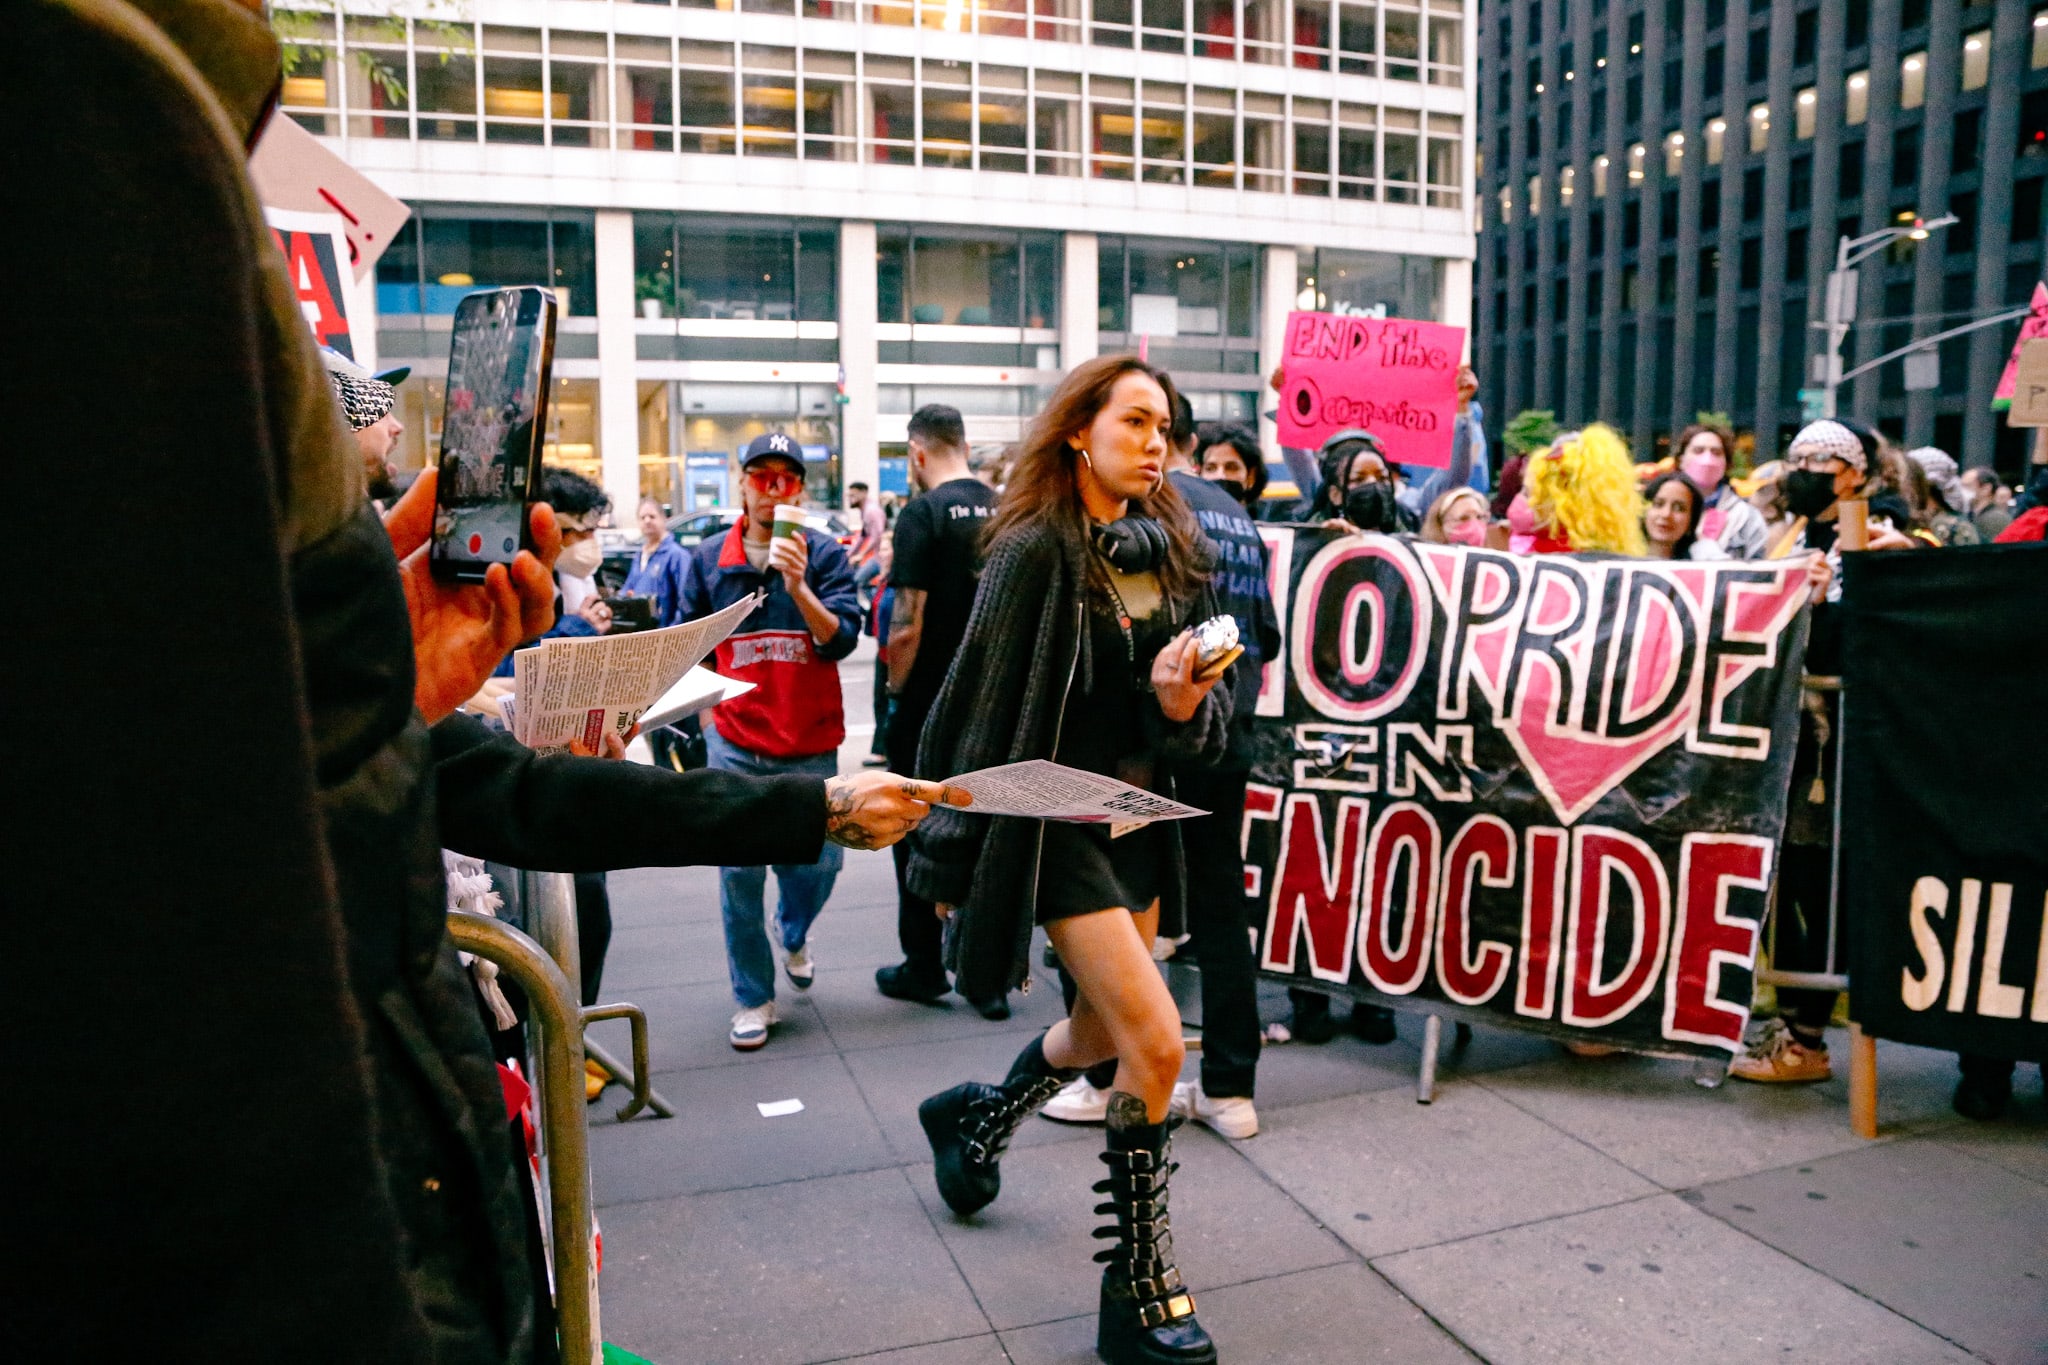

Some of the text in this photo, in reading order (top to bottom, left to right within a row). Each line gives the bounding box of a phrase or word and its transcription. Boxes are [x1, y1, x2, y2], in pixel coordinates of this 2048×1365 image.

[1292, 317, 1369, 361] END
[1438, 551, 1778, 760] PRIDE
[1295, 724, 1473, 801] IN
[1240, 782, 1775, 1052] ENOCIDE
